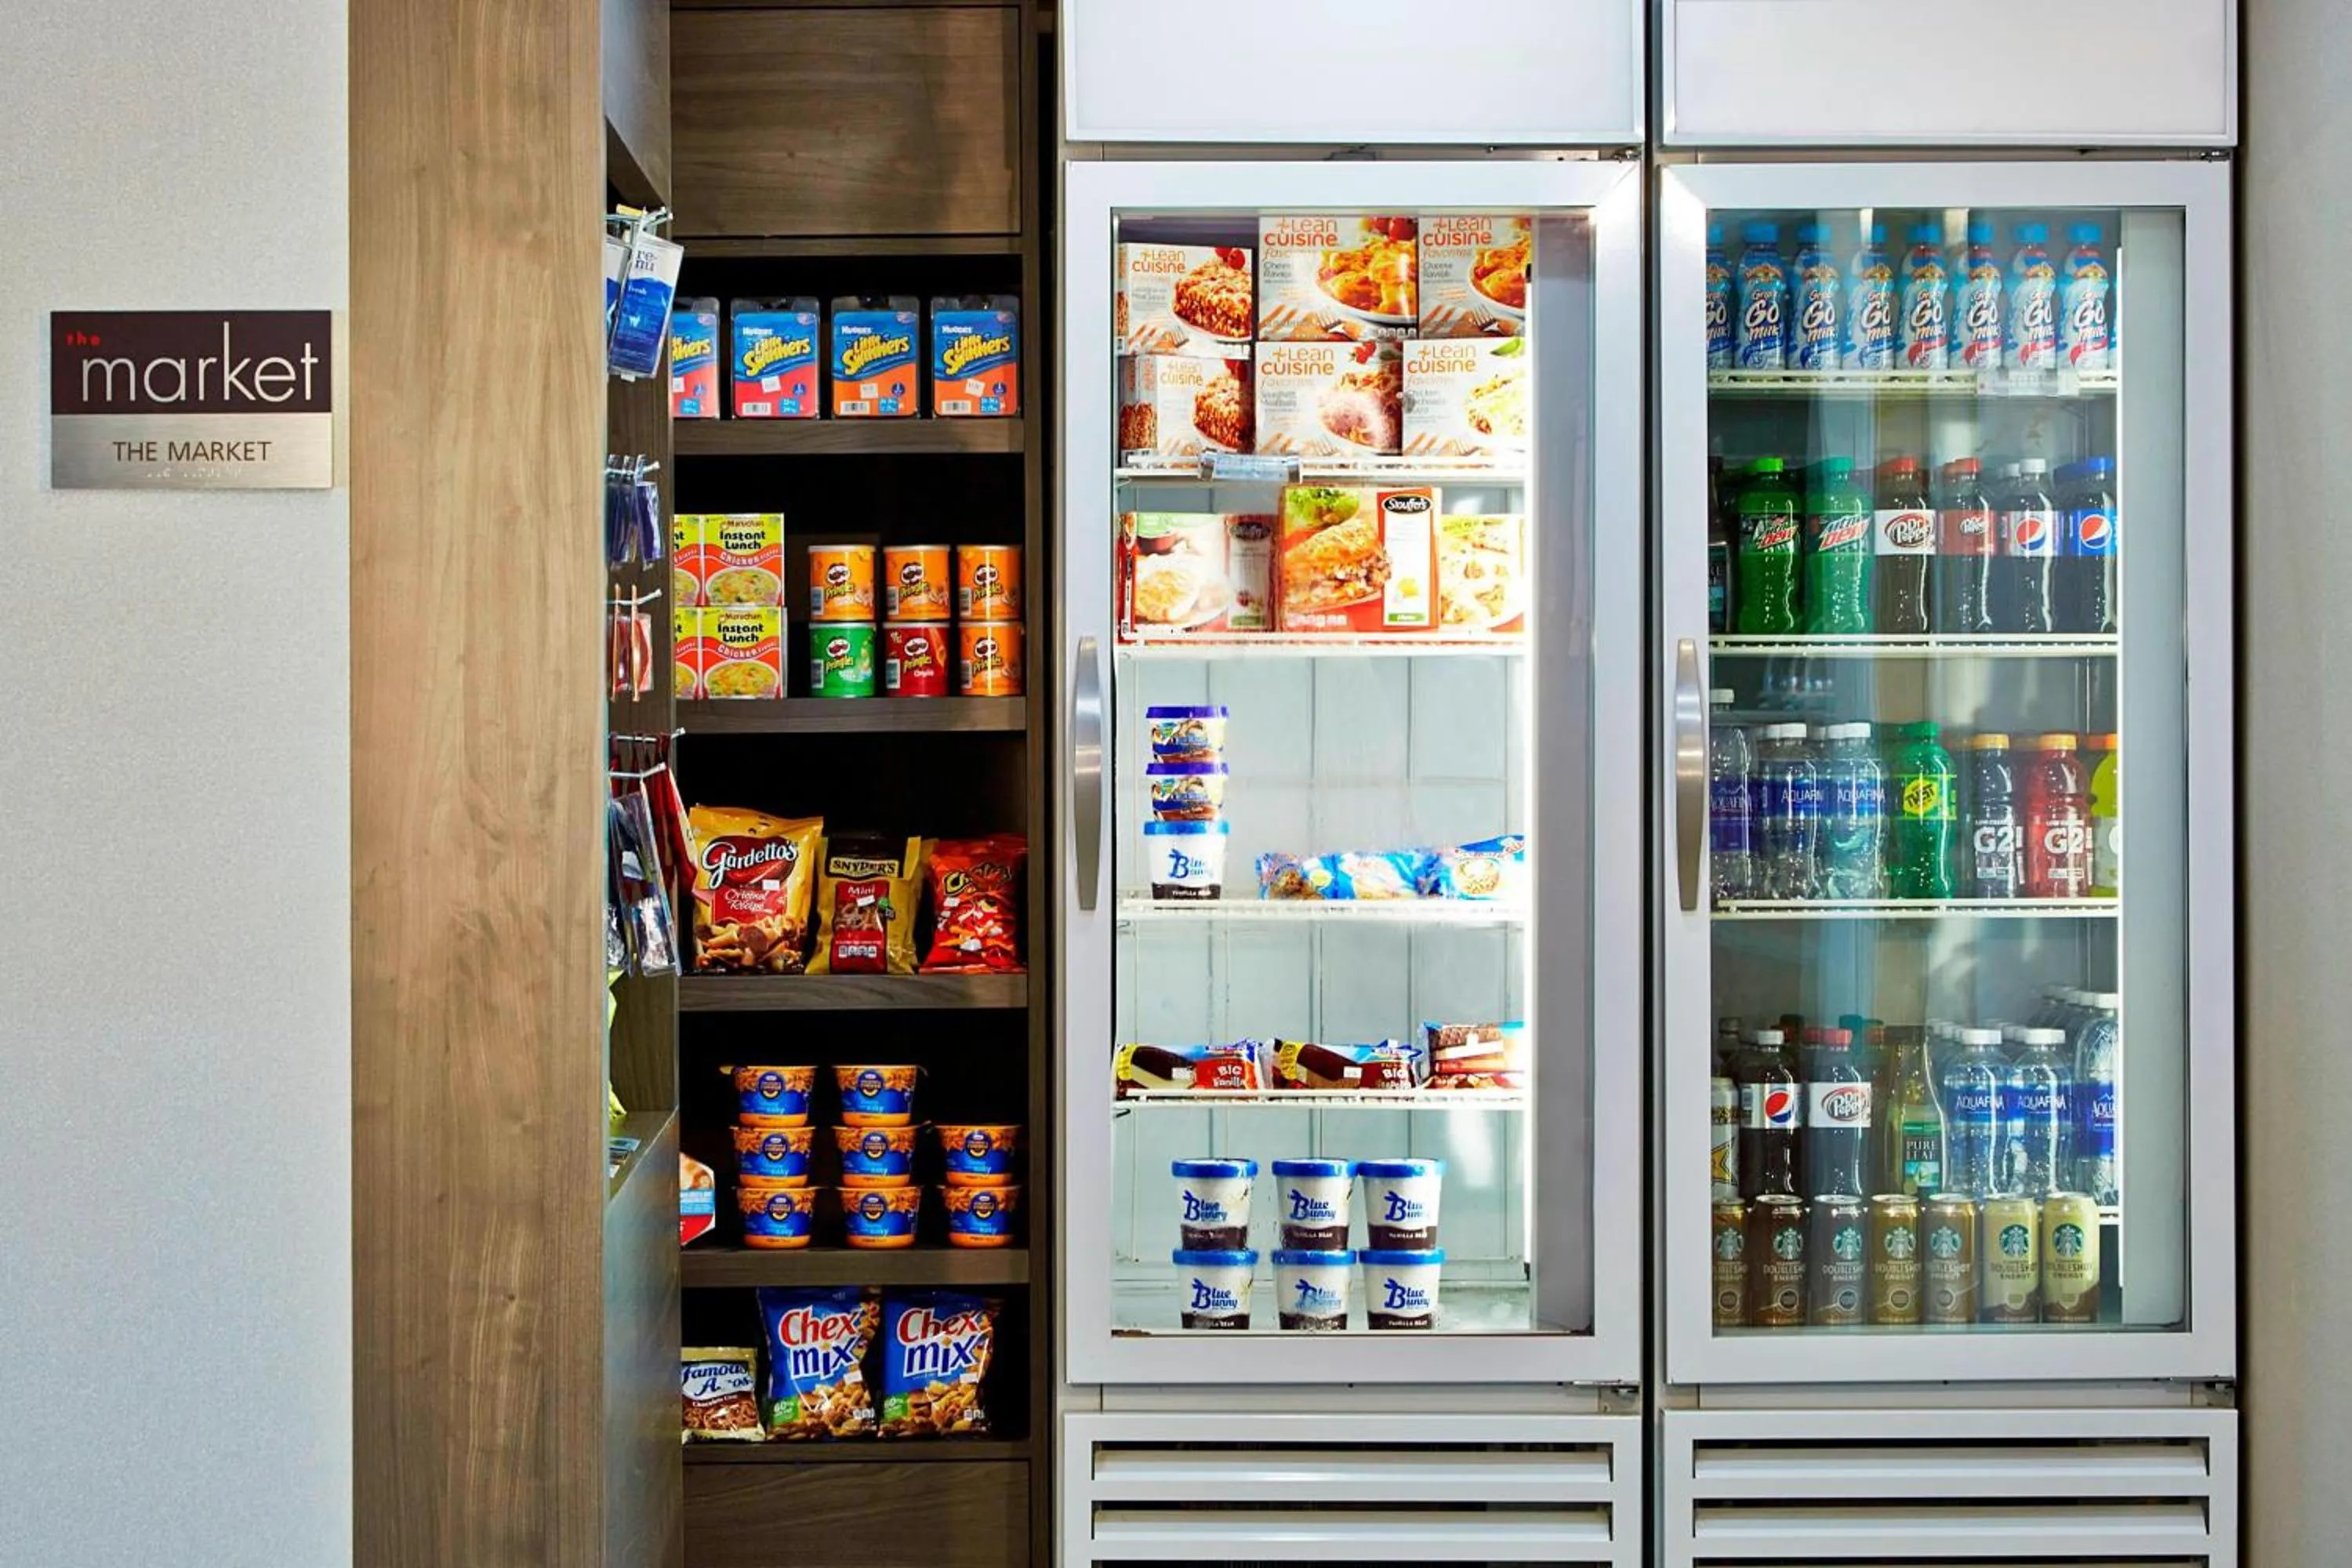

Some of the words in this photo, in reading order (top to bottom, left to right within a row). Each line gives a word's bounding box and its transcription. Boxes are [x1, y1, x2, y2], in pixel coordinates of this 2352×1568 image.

[1292, 217, 1338, 233] Lean
[1449, 216, 1492, 231] Lean
[1265, 233, 1338, 247] cuisine
[1423, 231, 1492, 246] cuisine
[1152, 248, 1185, 261] Lean
[1131, 260, 1186, 274] cuisine
[1288, 347, 1334, 361] Lean
[1432, 345, 1476, 359] Lean
[82, 321, 318, 402] market
[1261, 361, 1334, 376] cuisine
[1407, 359, 1476, 374] cuisine
[1160, 371, 1203, 386] cuisine
[113, 441, 157, 461] THE
[168, 441, 271, 461] MARKET
[720, 530, 766, 541] Instant
[724, 541, 761, 550] Lunch
[720, 551, 760, 565] Chicken
[717, 623, 764, 634] Instant
[722, 633, 760, 643] Lunch
[717, 644, 757, 659] Chicken
[702, 840, 797, 890] Gardetto's
[848, 884, 875, 895] Mini
[1217, 1064, 1243, 1076] BIG
[1955, 1094, 2005, 1111] AQUAFNA
[2017, 1094, 2067, 1111] AQUAFNA
[1906, 1140, 1938, 1149] PURE
[1288, 1189, 1329, 1221] Blue
[1191, 1277, 1231, 1309] Blue
[1384, 1277, 1425, 1309] Blue
[780, 1306, 861, 1345] Chex
[899, 1308, 982, 1343] Chex
[793, 1338, 859, 1377] mix
[906, 1334, 982, 1376] mix
